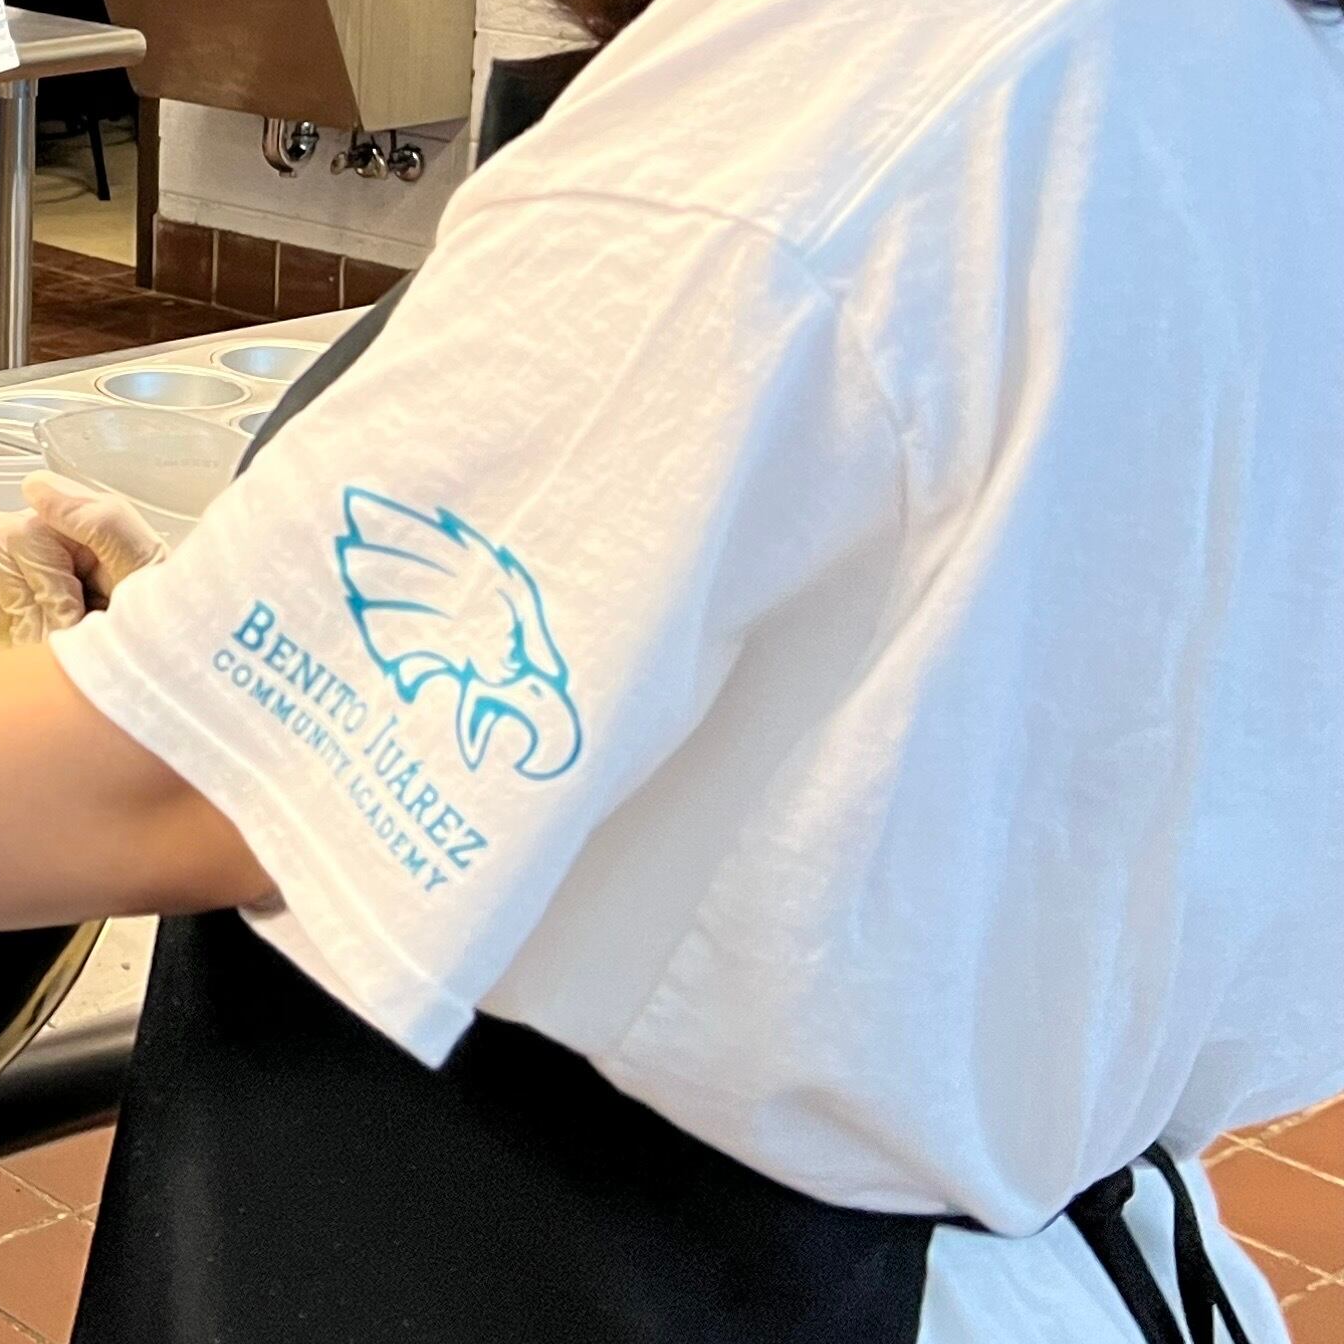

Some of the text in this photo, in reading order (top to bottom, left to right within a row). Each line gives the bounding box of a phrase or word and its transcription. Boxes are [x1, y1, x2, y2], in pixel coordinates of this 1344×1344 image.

[232, 599, 368, 735] BENITO
[212, 648, 449, 893] COMMUNITY ACADEMY
